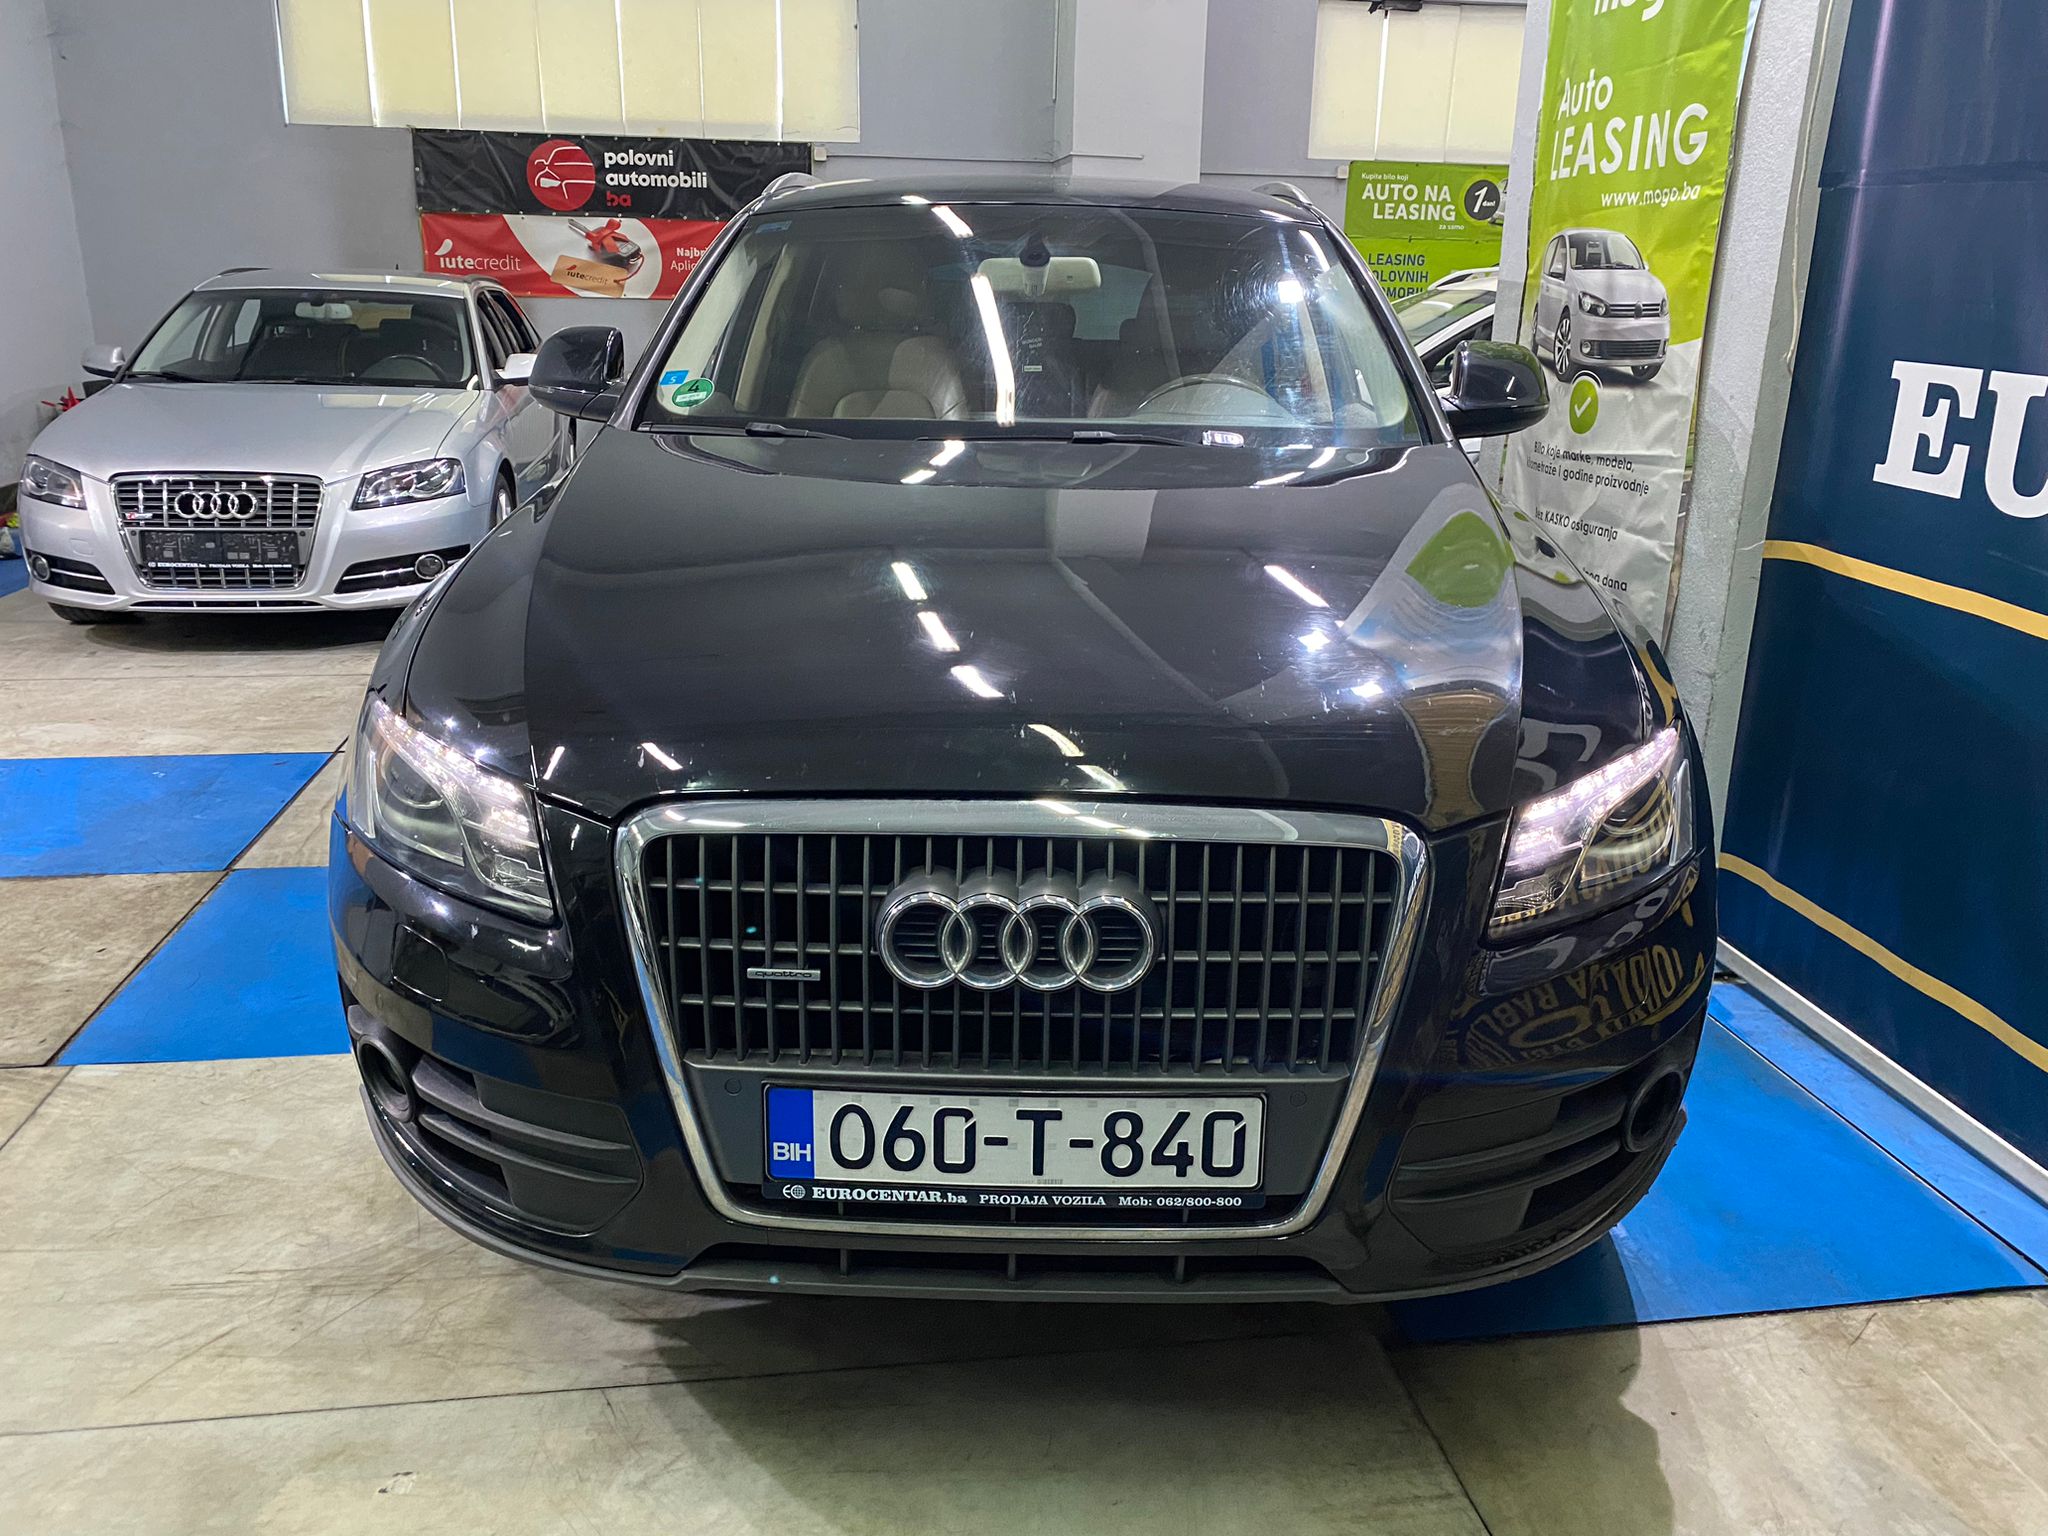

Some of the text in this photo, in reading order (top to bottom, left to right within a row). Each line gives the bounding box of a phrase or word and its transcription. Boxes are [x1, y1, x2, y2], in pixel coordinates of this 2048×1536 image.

[1557, 68, 1614, 121] Auto
[1550, 102, 1709, 181] LEASING
[603, 149, 674, 168] polovni
[605, 171, 708, 188] automobili
[1361, 172, 1382, 181] Kupite
[1397, 173, 1409, 183] koji
[1361, 183, 1451, 203] AUTO NA
[1473, 186, 1488, 213] 1
[1601, 181, 1701, 207] www.mogo.ba
[1373, 202, 1456, 222] LEASING
[438, 250, 521, 271] iutecredit
[1368, 253, 1426, 266] LEASING
[566, 268, 609, 285] iutecredit
[1372, 270, 1429, 283] OLOVNIH
[687, 379, 700, 392] 4
[1872, 359, 2048, 519] EU
[1534, 441, 1545, 454] Bilo
[1546, 443, 1561, 460] koje
[1596, 455, 1635, 473] modela,
[1563, 467, 1594, 483] godine
[1595, 474, 1650, 497] proizvodnje
[1544, 510, 1571, 528] KASKO
[1571, 519, 1618, 542] osiguranja
[1602, 574, 1628, 591] dana
[755, 970, 812, 978] quattro
[772, 1103, 1246, 1178] BIH 060-T-840
[811, 1186, 1242, 1208] EUROCENTAR.ba PRODAJA VOZILA Mob: 062/800-800
